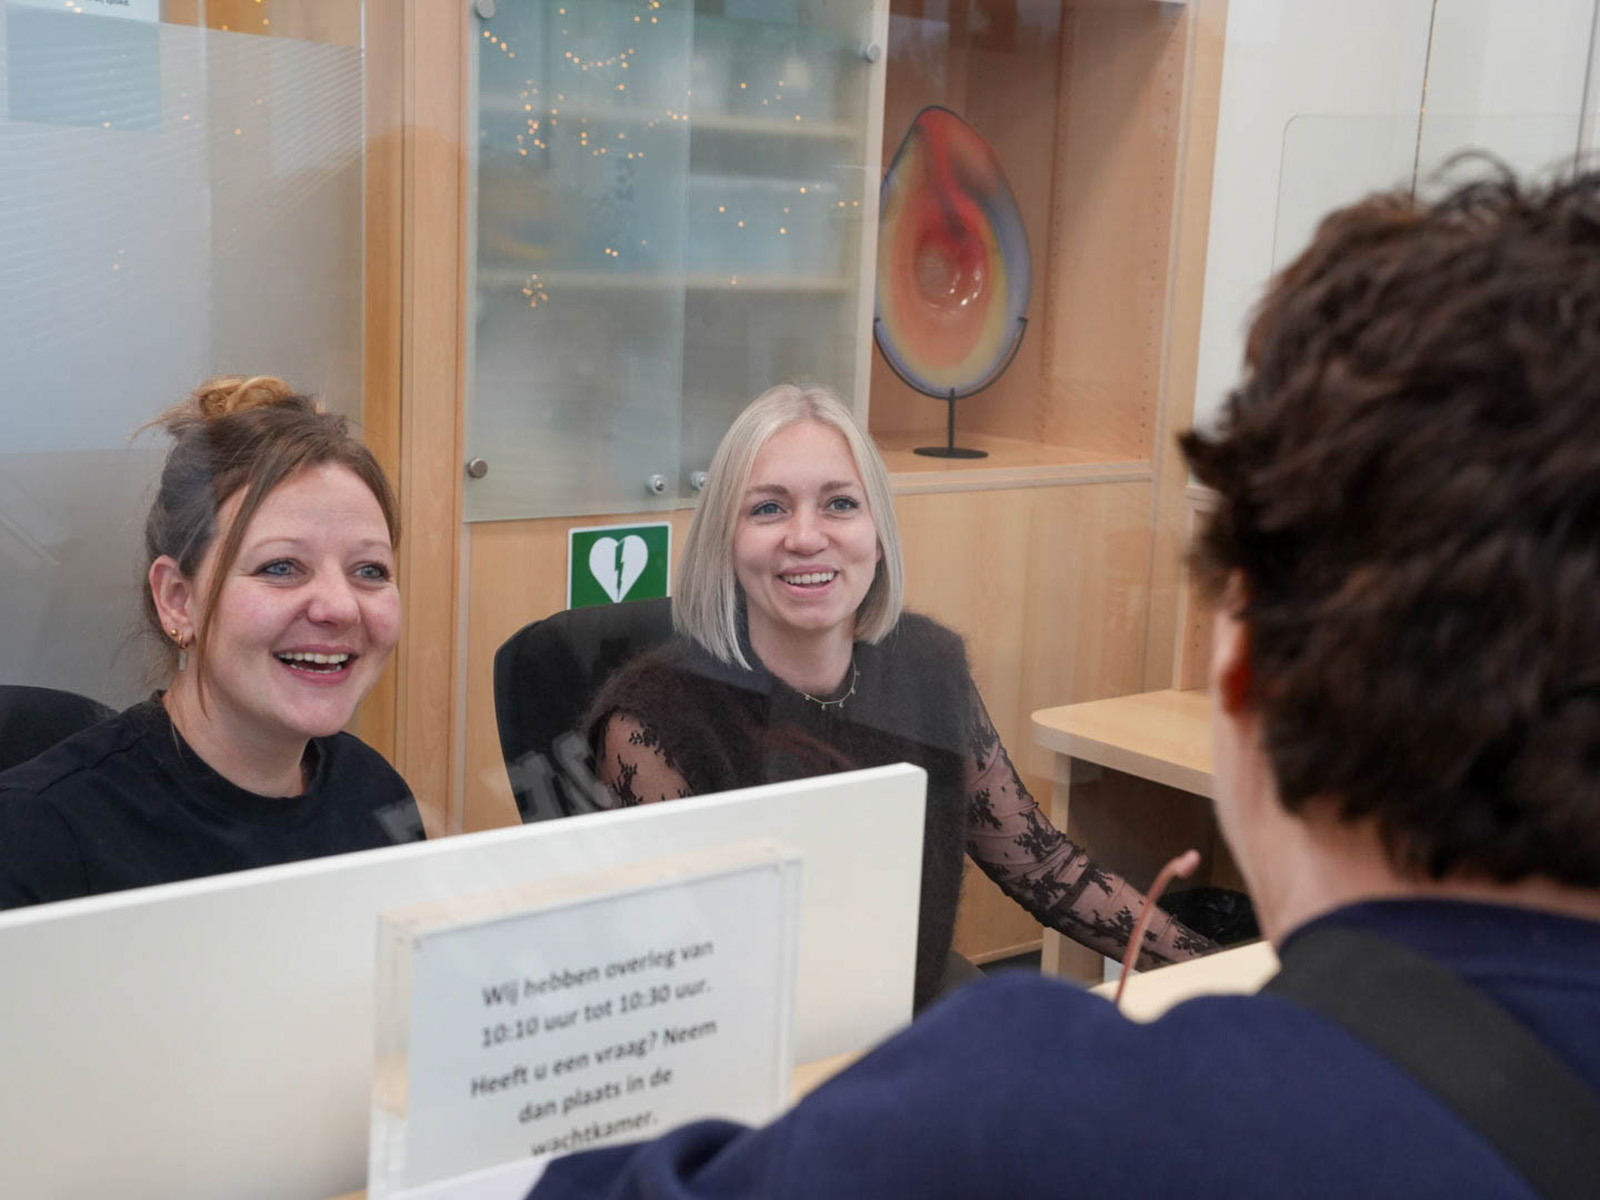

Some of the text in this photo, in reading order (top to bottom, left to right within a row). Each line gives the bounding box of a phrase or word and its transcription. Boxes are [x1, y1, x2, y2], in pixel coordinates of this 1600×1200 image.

[482, 941, 714, 1006] Wij hebben overleg van
[482, 978, 712, 1047] 10:10 uur tot 10:30 uur.
[470, 1020, 718, 1097] Heeft u een vraag? Neem
[518, 1067, 673, 1124] dan plaats in de
[531, 1111, 658, 1156] wachtkamer.
